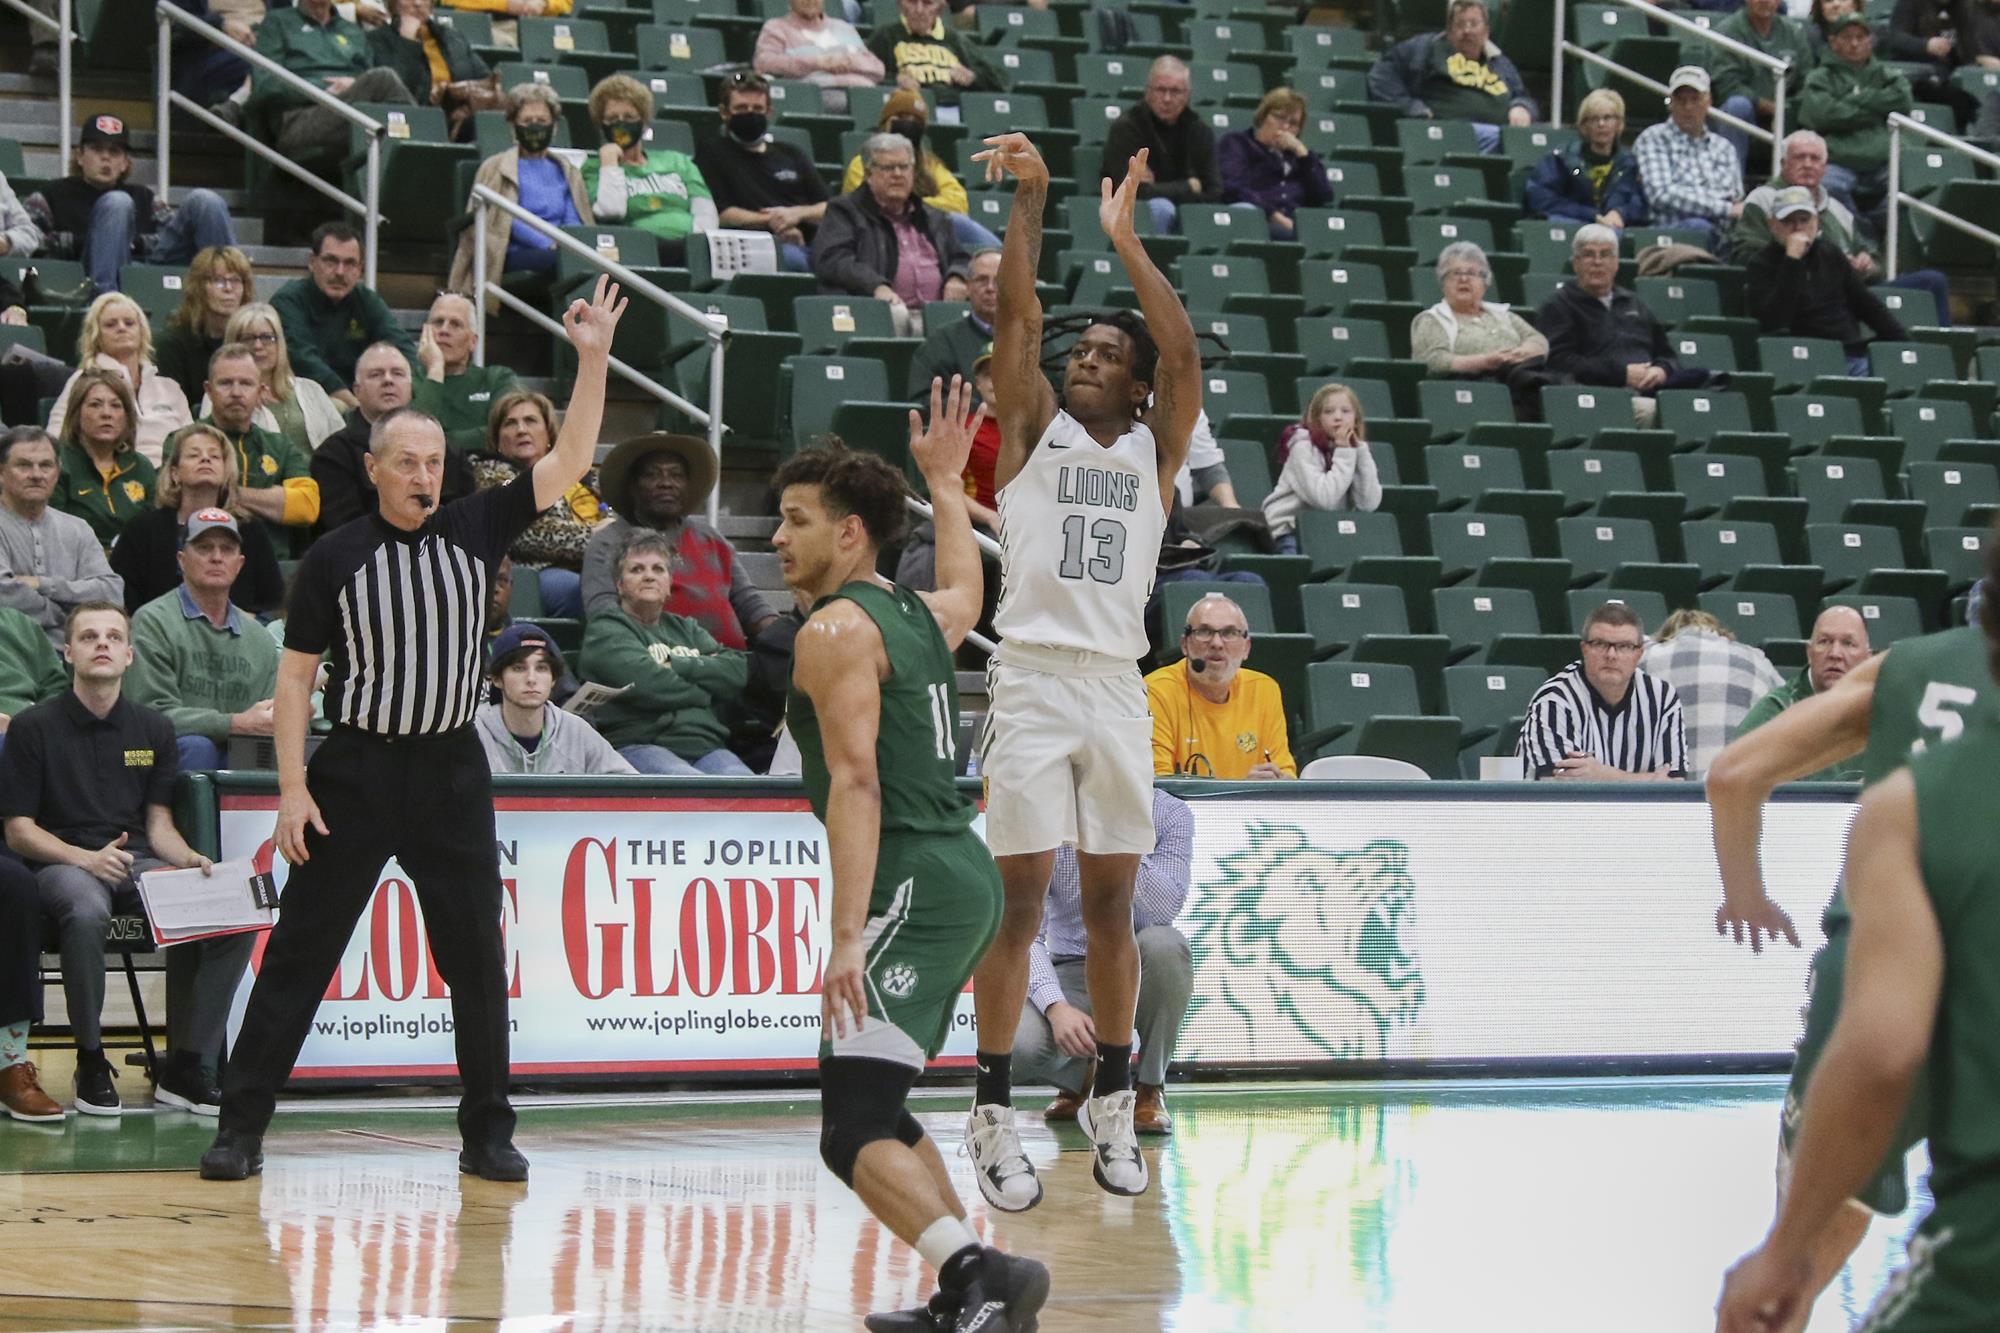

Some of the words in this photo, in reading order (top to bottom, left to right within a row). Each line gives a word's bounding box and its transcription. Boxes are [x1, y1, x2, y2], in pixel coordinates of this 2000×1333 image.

[1058, 466, 1140, 512] LIONS
[1059, 514, 1127, 585] 13
[928, 682, 956, 761] 11
[1911, 681, 1977, 755] 5
[627, 840, 686, 866] THE
[703, 839, 821, 866] JOPLIN
[561, 836, 824, 1001] GLOBE
[586, 1009, 821, 1035] www.joplinglobe.com
